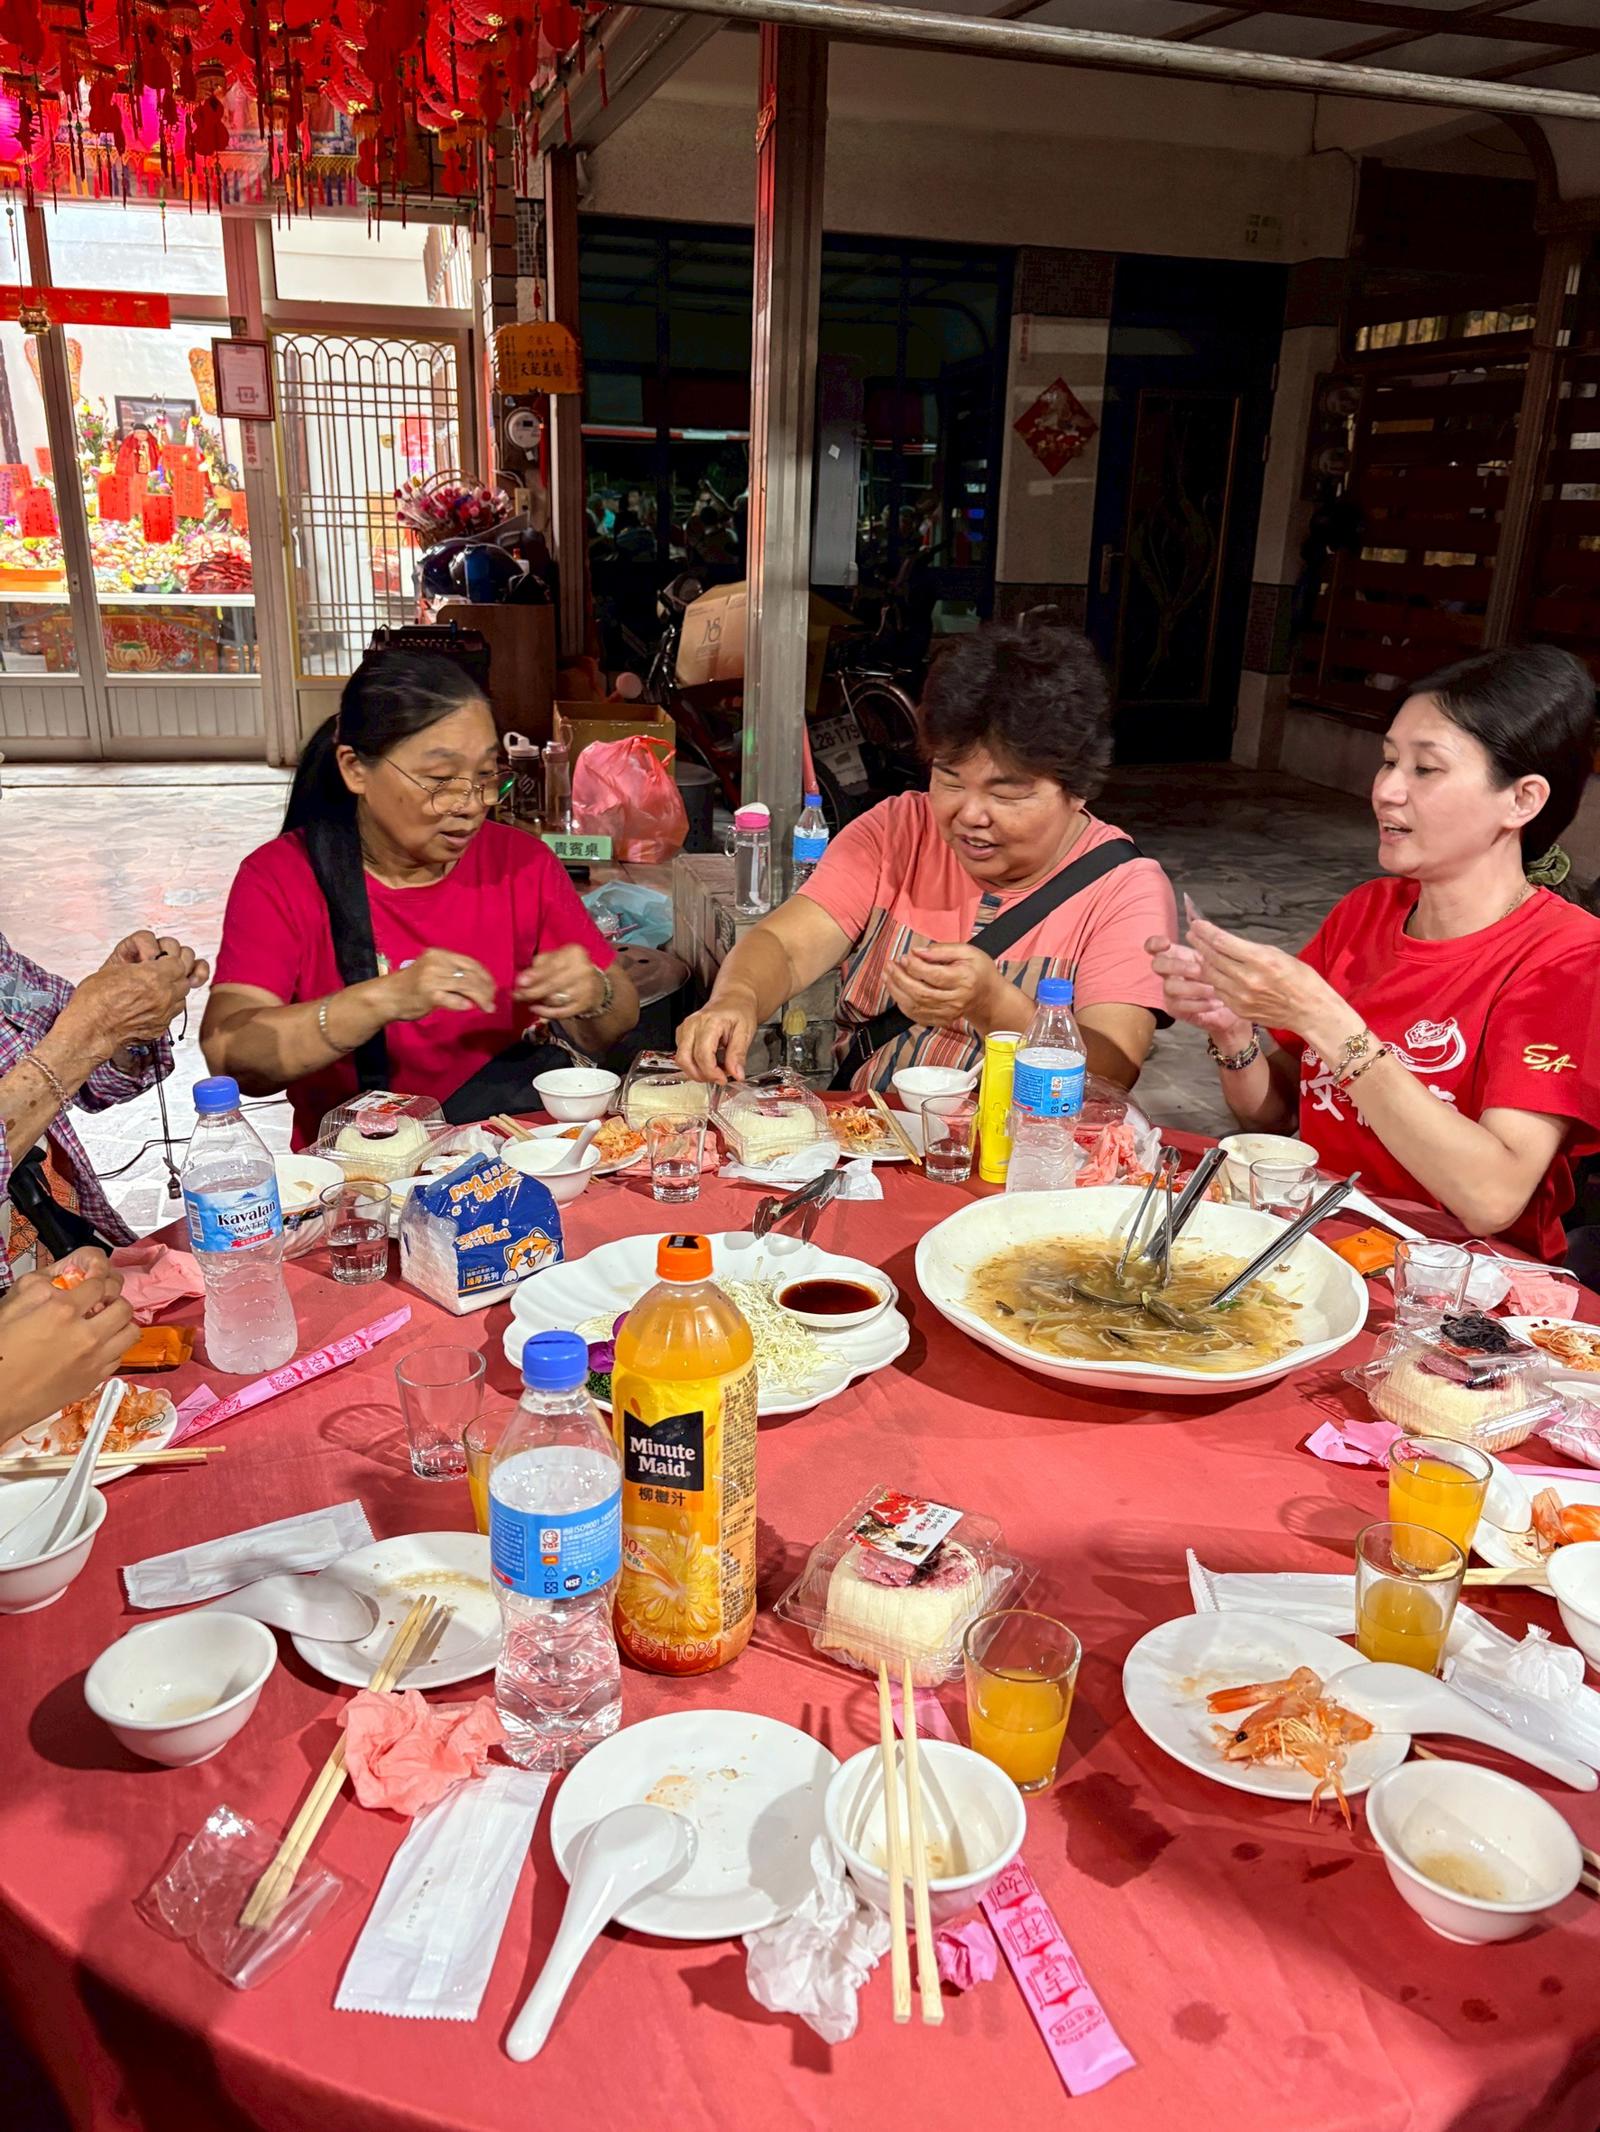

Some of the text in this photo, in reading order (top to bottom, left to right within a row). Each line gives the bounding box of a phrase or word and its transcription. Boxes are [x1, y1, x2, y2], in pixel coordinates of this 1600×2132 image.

[555, 841, 599, 857] 貴賓桌
[217, 1201, 276, 1226] Kavalan
[234, 1217, 269, 1233] WATER
[630, 1436, 696, 1461] Minute
[638, 1456, 687, 1478] Maid
[638, 1486, 687, 1507] 柳橙汁
[565, 1577, 581, 1588] NSF
